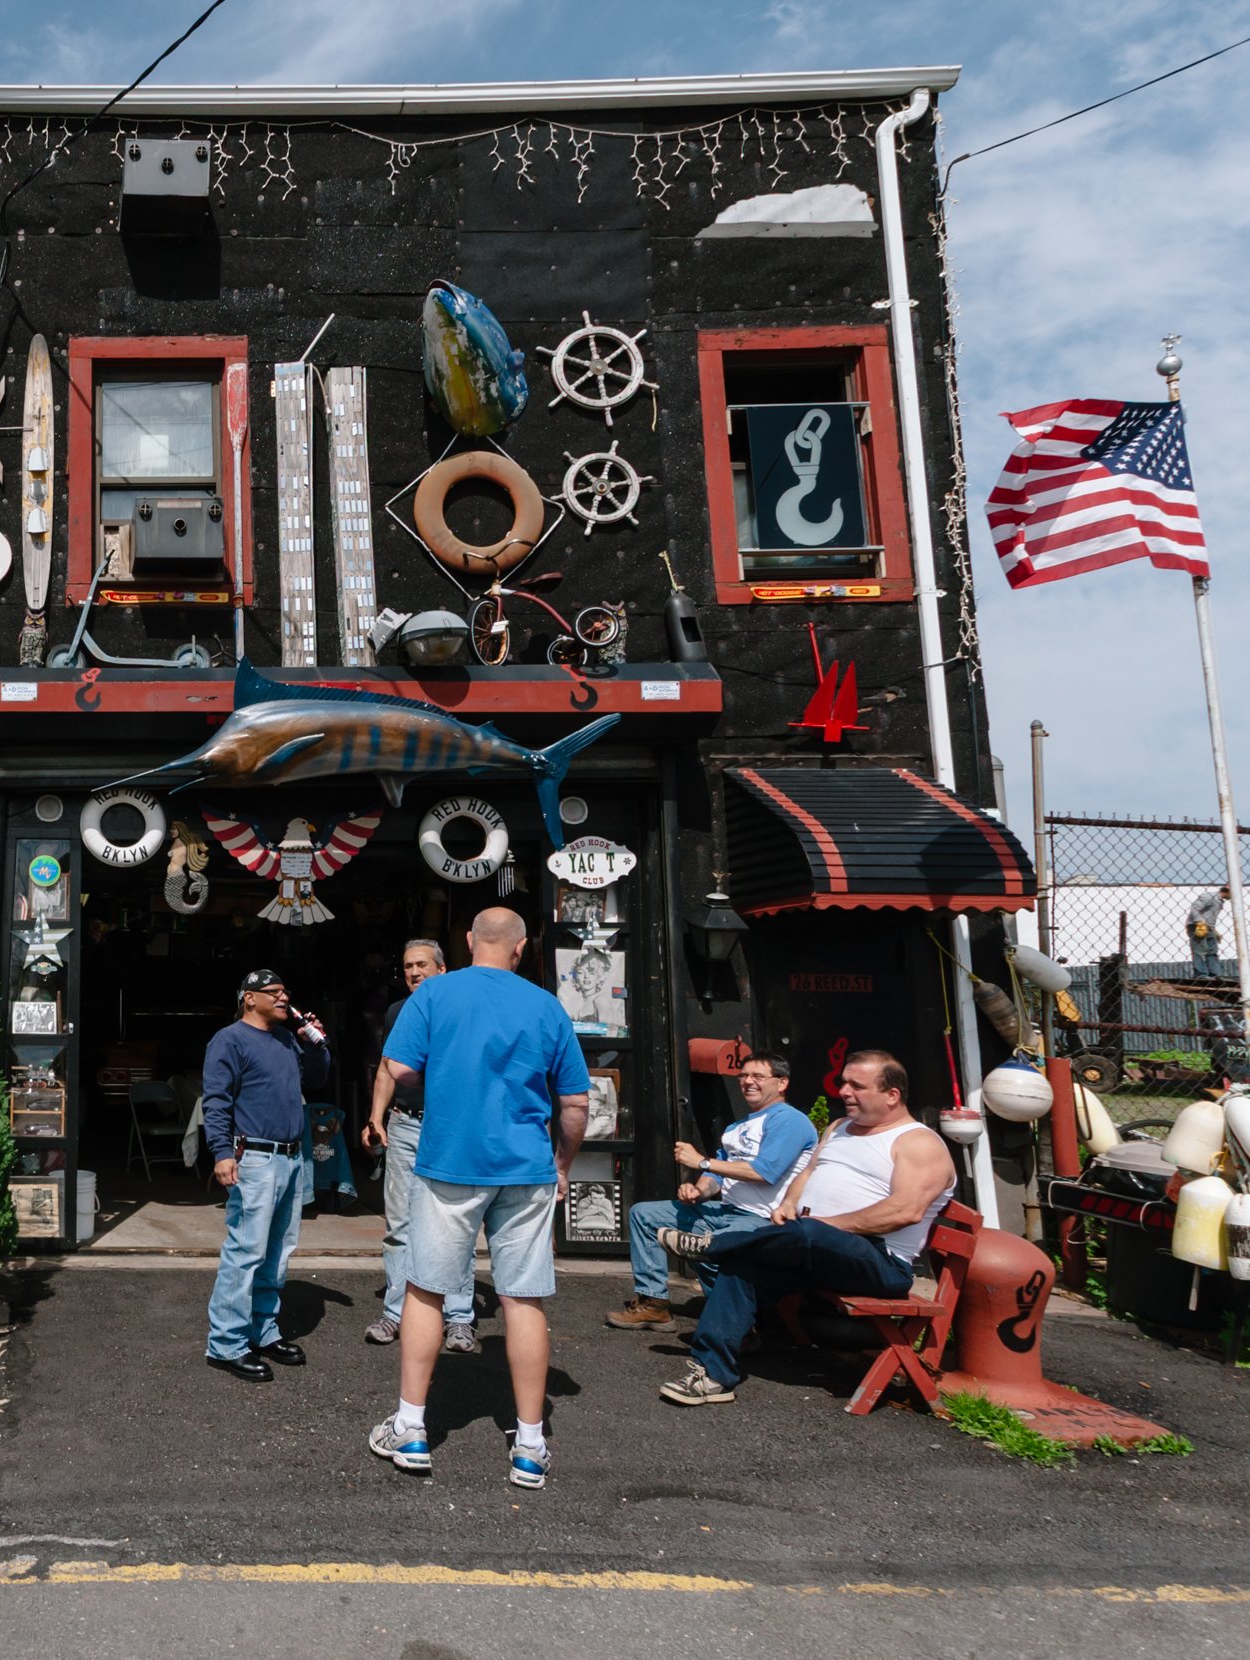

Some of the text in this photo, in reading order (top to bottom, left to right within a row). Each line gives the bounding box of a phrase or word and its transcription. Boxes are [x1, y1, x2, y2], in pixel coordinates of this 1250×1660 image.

[124, 789, 159, 811] HOOK
[431, 799, 504, 829] RED HOOK
[102, 845, 149, 863] BKLYN
[570, 839, 611, 852] RED HOOK
[442, 858, 491, 878] B'KLYN
[582, 877, 605, 885] CLUB
